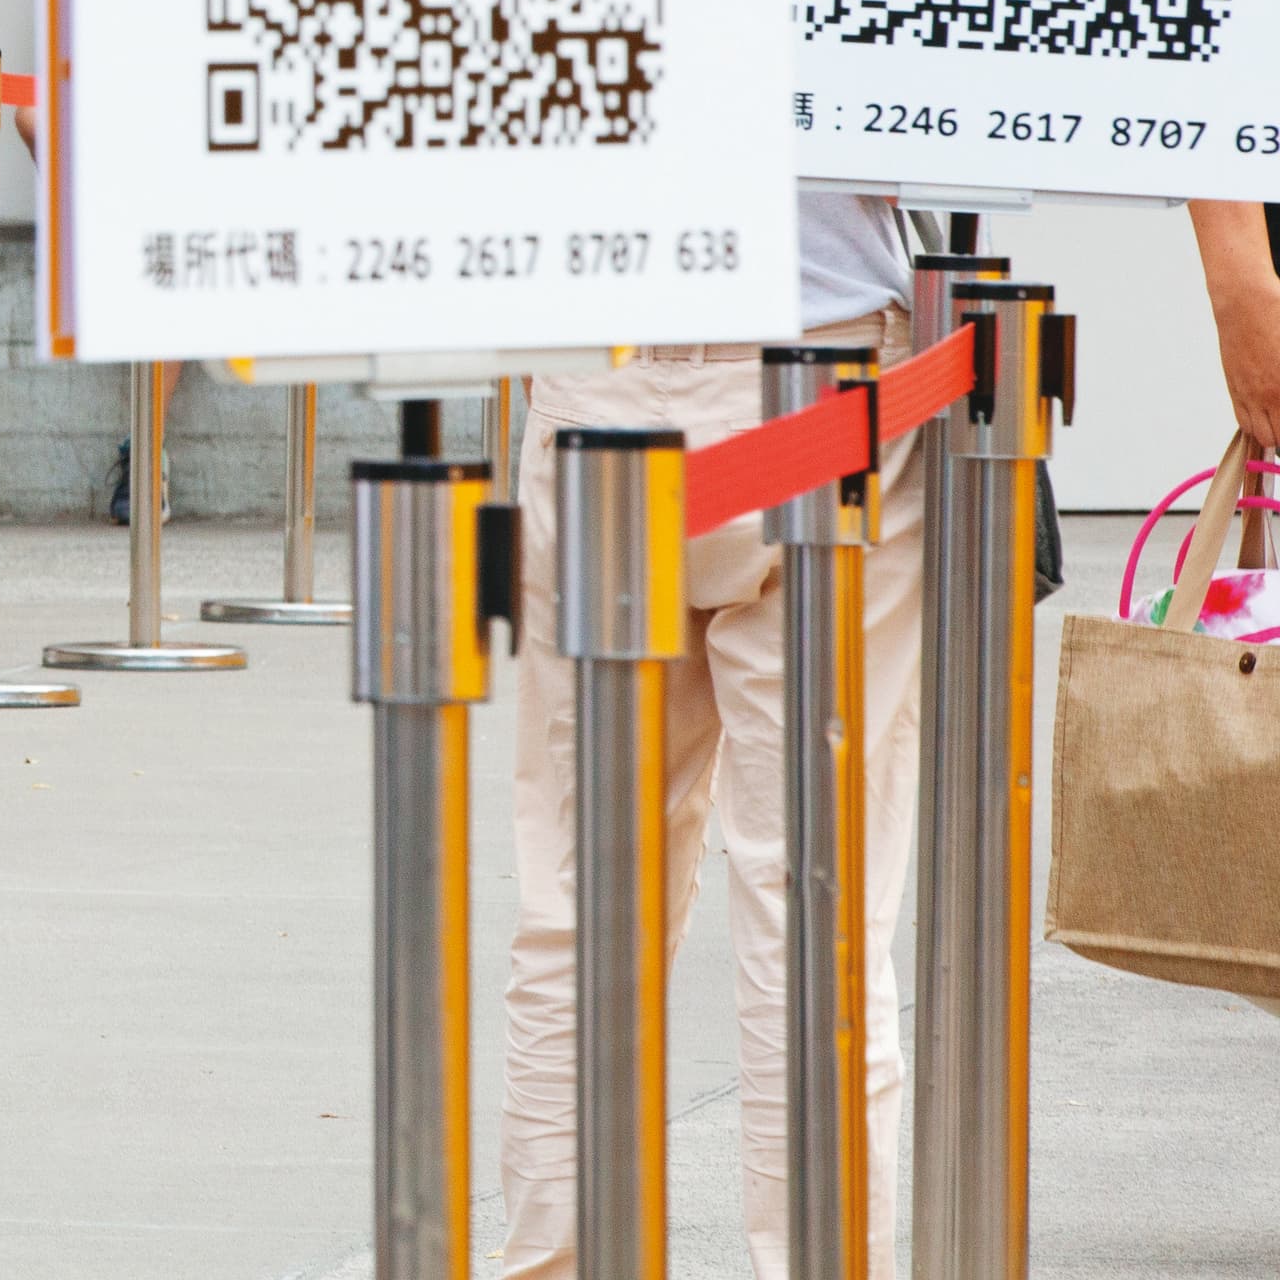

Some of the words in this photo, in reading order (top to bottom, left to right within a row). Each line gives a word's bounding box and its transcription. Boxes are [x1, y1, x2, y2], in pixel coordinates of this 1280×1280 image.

[863, 103, 958, 137] 2246
[987, 110, 1082, 143] 2617
[1111, 117, 1207, 150] 8707
[346, 237, 431, 283] 2246
[457, 234, 540, 280] 2617
[567, 231, 651, 276] 8707
[676, 229, 739, 273] 638
